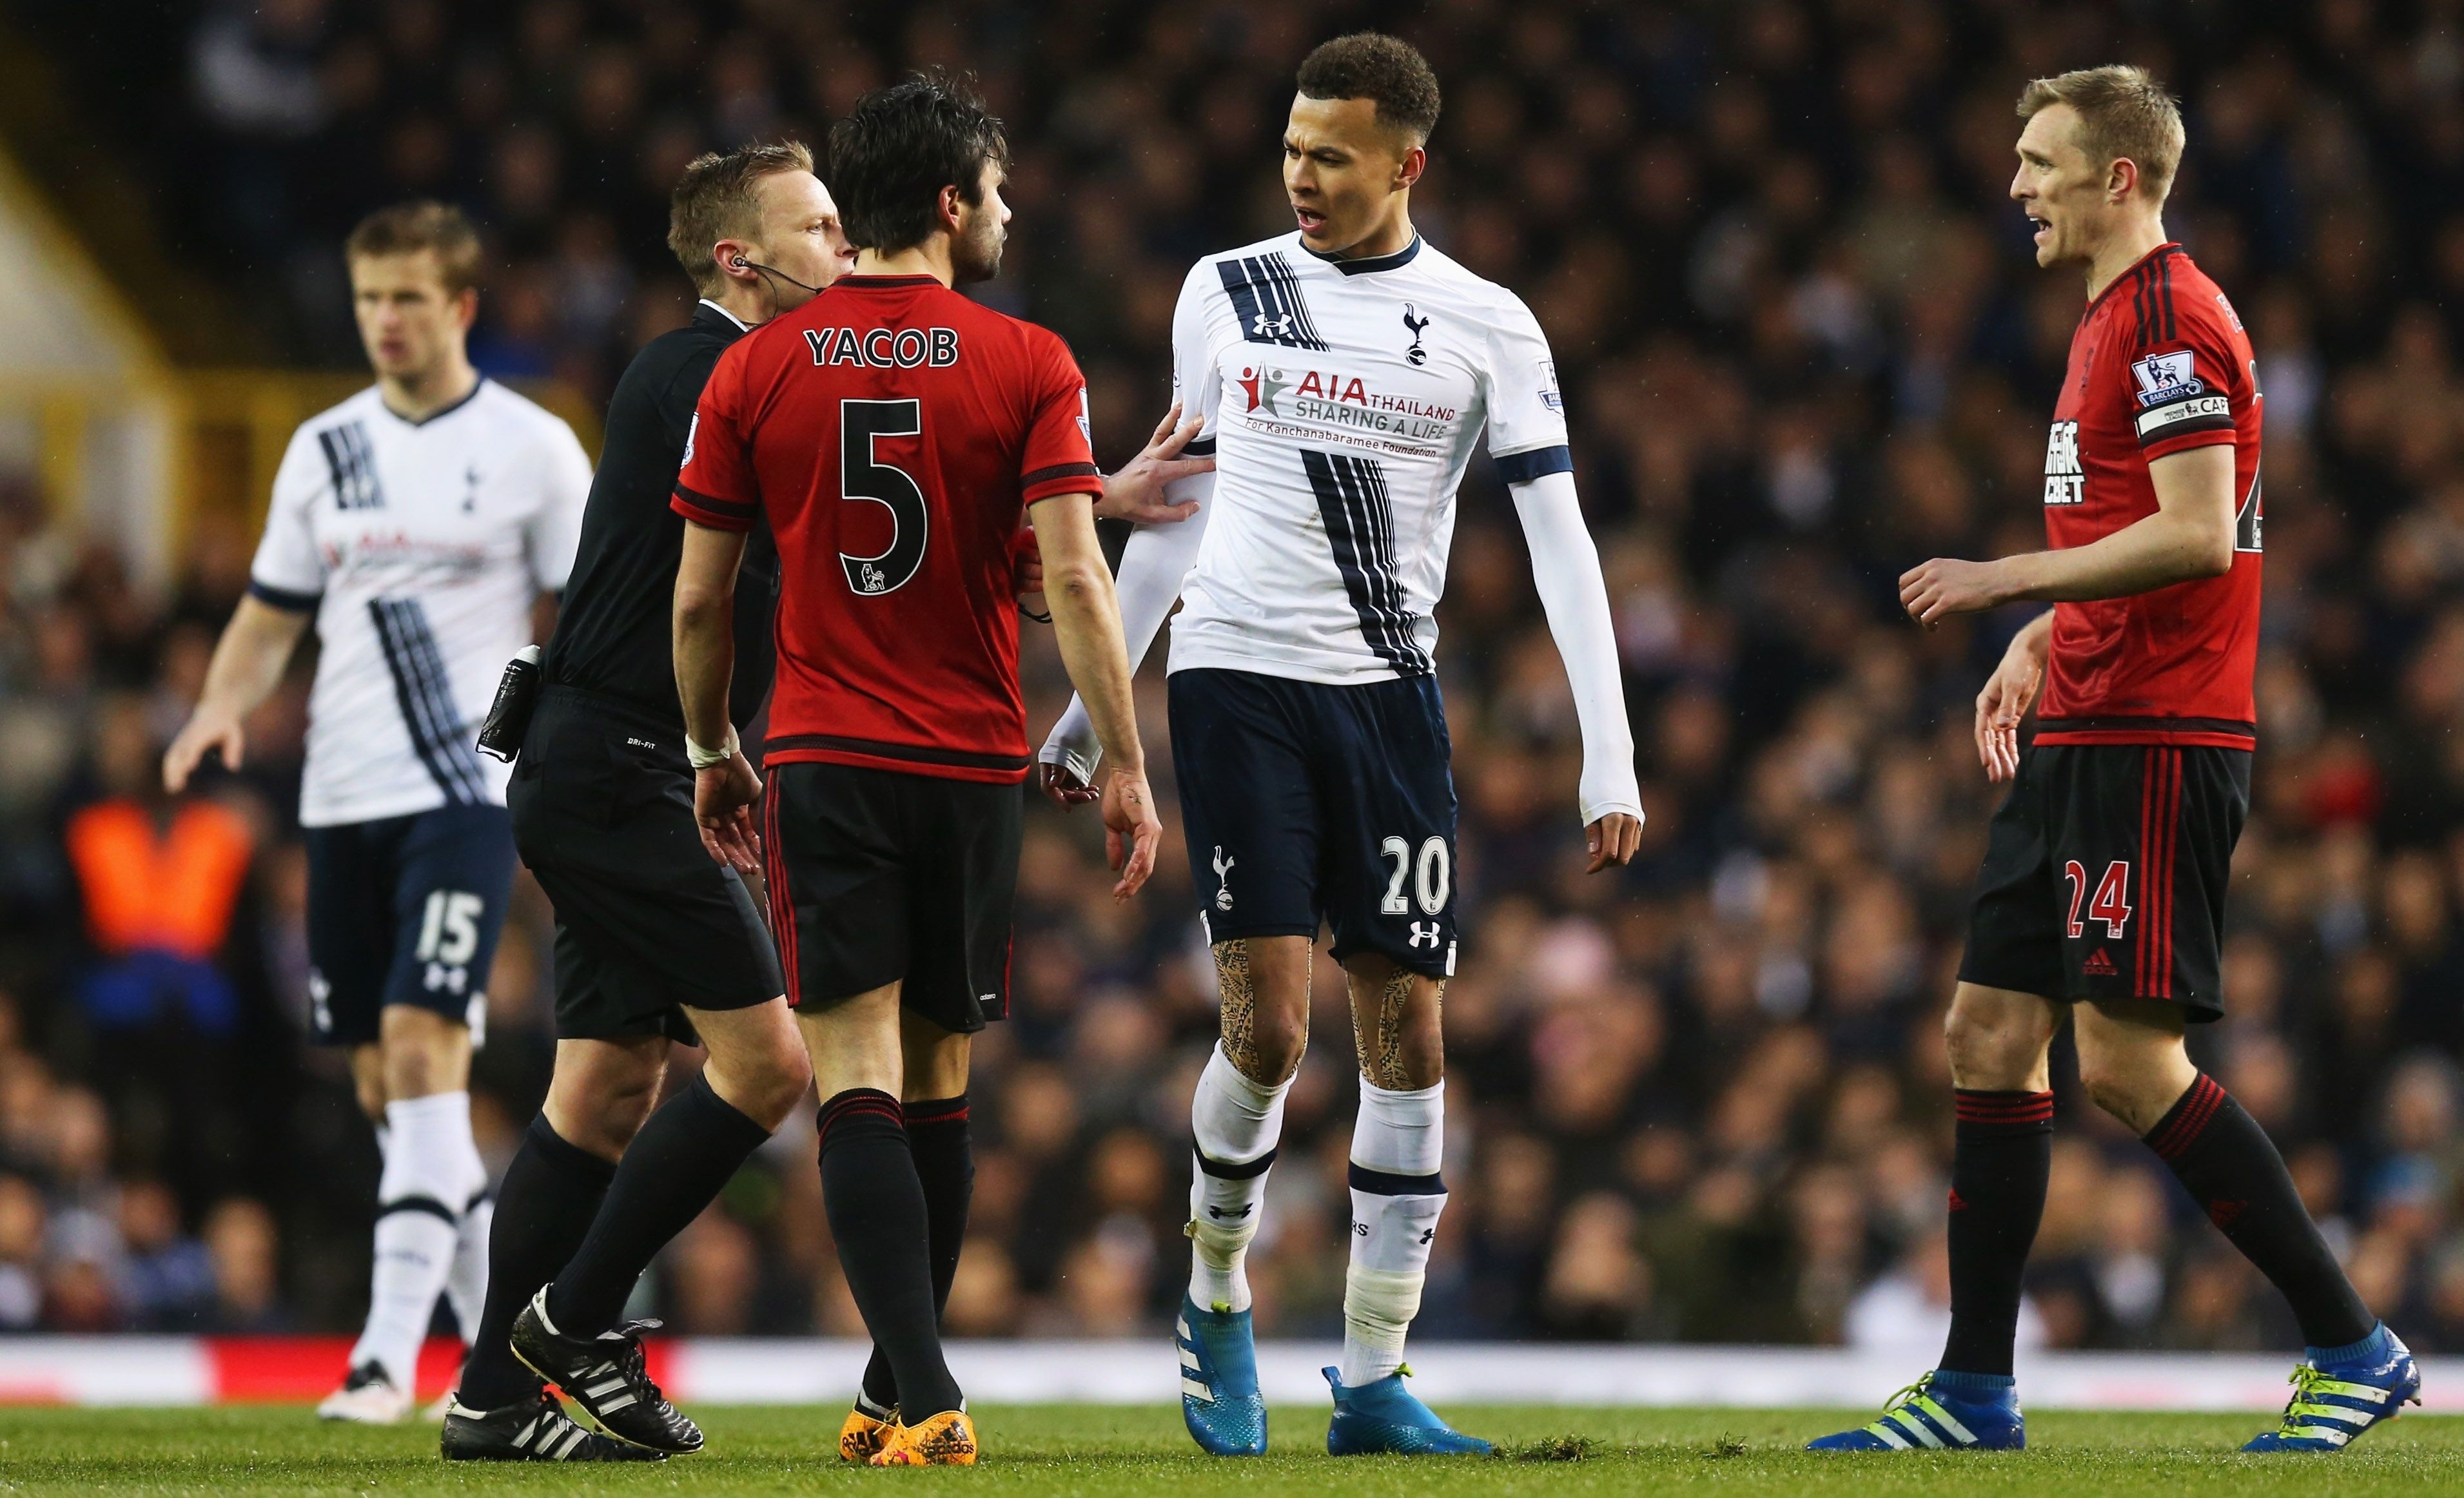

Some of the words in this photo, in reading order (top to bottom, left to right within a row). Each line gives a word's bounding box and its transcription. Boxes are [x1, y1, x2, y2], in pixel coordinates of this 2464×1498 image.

[803, 327, 959, 369] YACOB
[1296, 371, 1367, 406] AIA
[1371, 394, 1454, 420] THAILAND
[2149, 387, 2184, 402] BARCLAYS
[2200, 398, 2229, 413] CAP
[1245, 418, 1262, 431] For
[1267, 423, 1379, 449] Kanchanabaramee
[1384, 442, 1436, 458] Foundation
[1296, 401, 1388, 430] SHARING
[1393, 420, 1405, 434] A
[1413, 423, 1447, 439] LIFE
[839, 398, 928, 596] 5
[627, 738, 656, 749] DRI-FIT
[1381, 835, 1450, 915] 20
[2065, 860, 2132, 939] 24
[413, 889, 484, 966] 15
